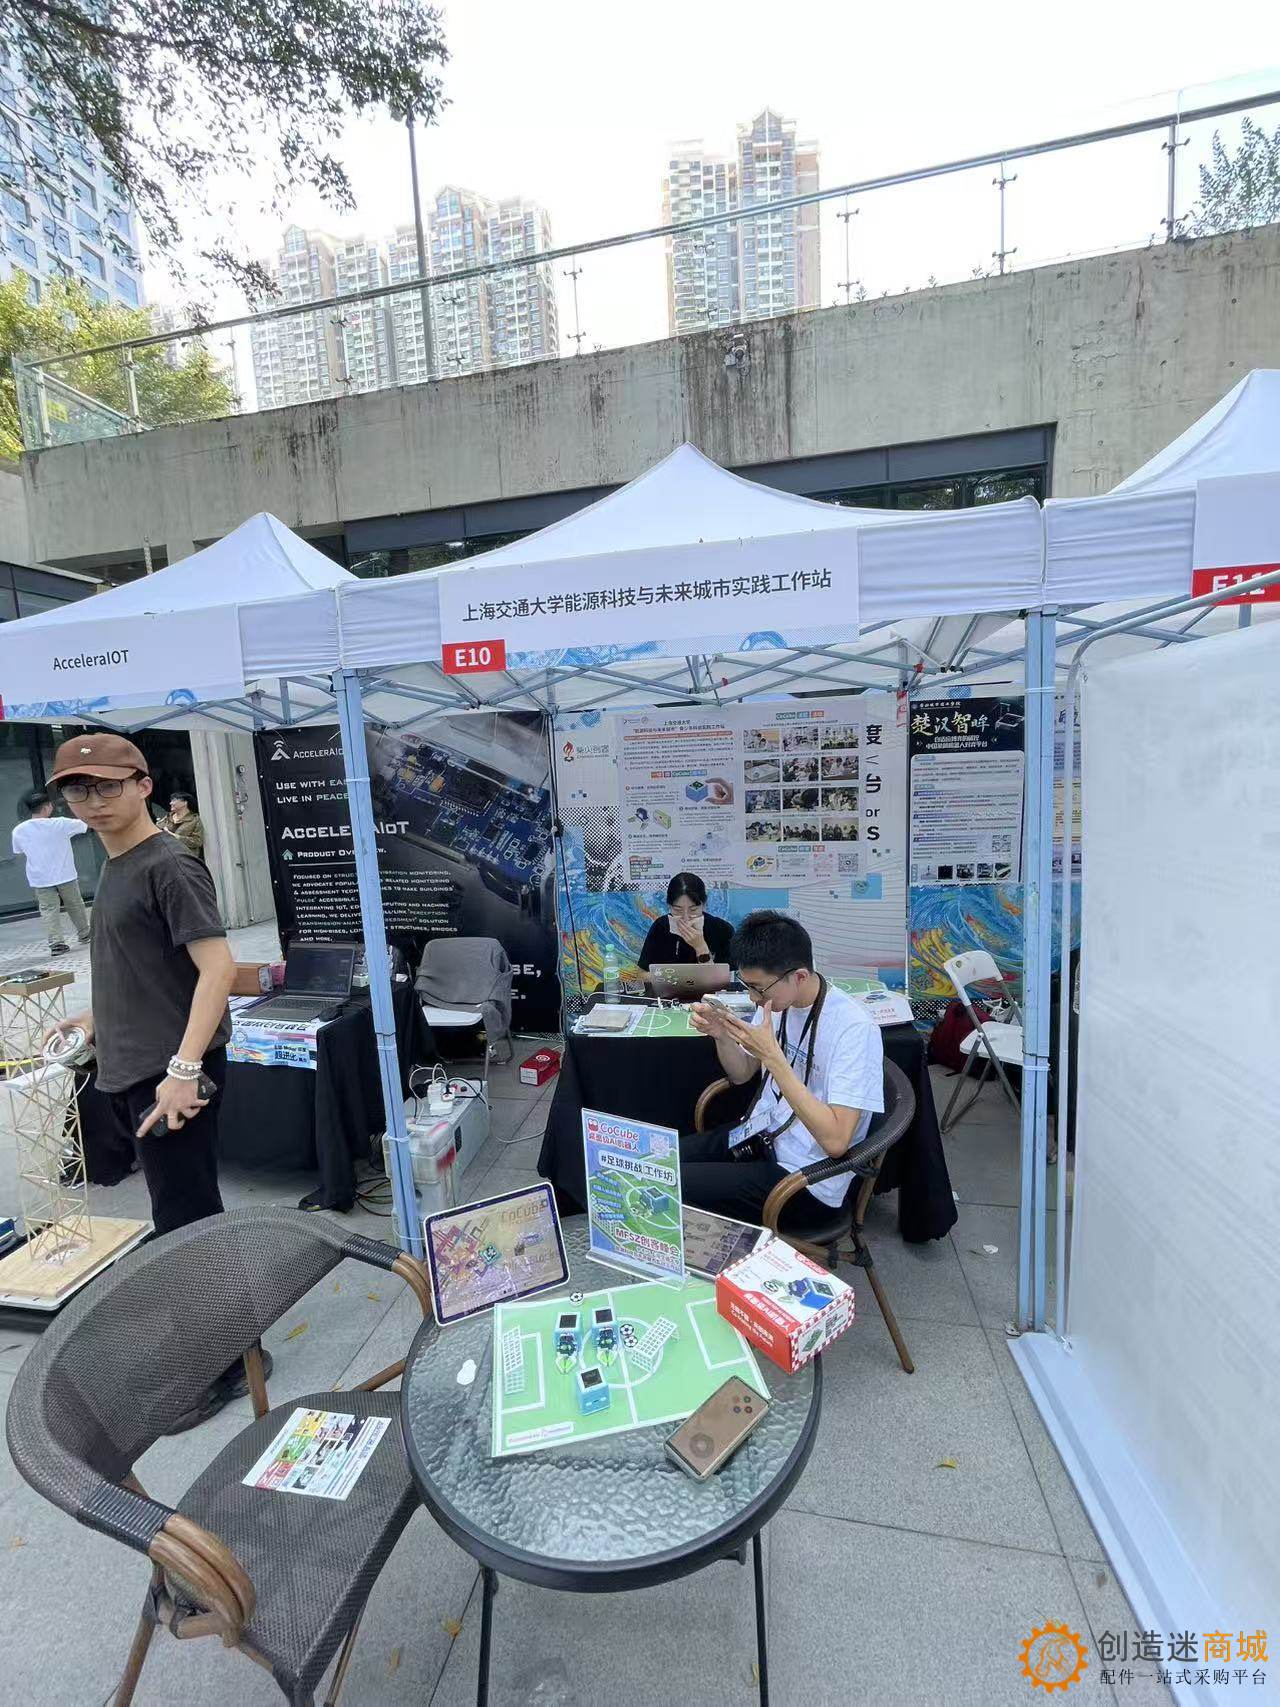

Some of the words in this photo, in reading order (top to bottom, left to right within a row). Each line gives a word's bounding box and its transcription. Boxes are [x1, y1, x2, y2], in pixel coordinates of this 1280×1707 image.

[462, 568, 832, 622] 上海交通大学能源科技与未来城市实践工作站
[53, 649, 130, 670] AcceleraIOT
[455, 646, 492, 668] E10
[275, 781, 297, 790] USE
[299, 780, 326, 789] WITH
[329, 779, 347, 787] EA
[277, 795, 299, 804] LIVE
[316, 792, 350, 801] PEACE
[297, 850, 336, 858] PRODUCT
[510, 963, 542, 978] SE,
[600, 1122, 640, 1142] CoCube
